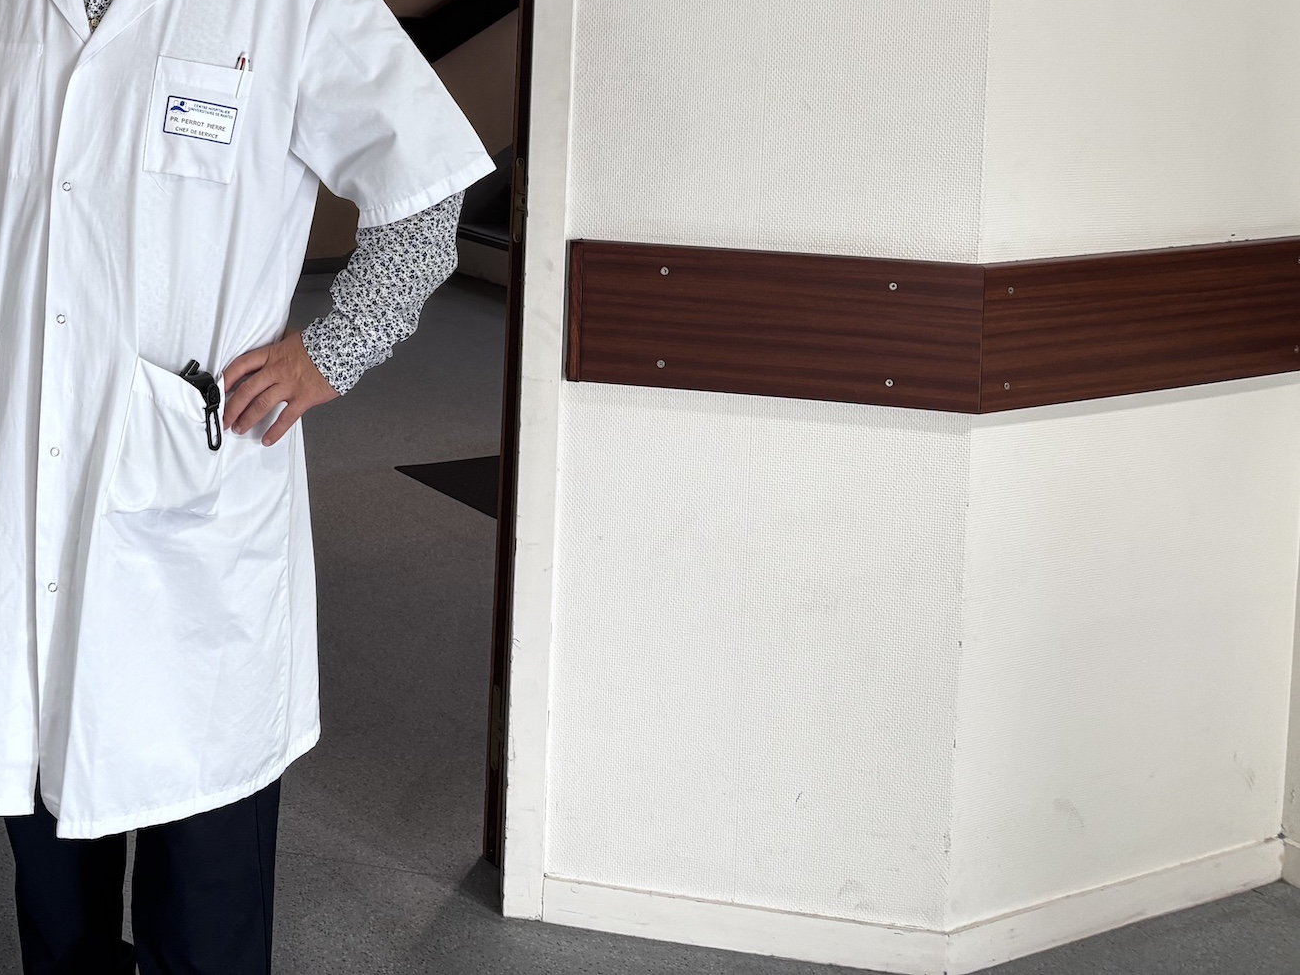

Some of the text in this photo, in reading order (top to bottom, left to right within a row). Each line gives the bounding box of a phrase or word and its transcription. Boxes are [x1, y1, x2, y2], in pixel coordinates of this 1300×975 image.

[181, 117, 205, 127] PERROT
[207, 123, 226, 132] PIERRE
[198, 131, 218, 139] SERVICE
